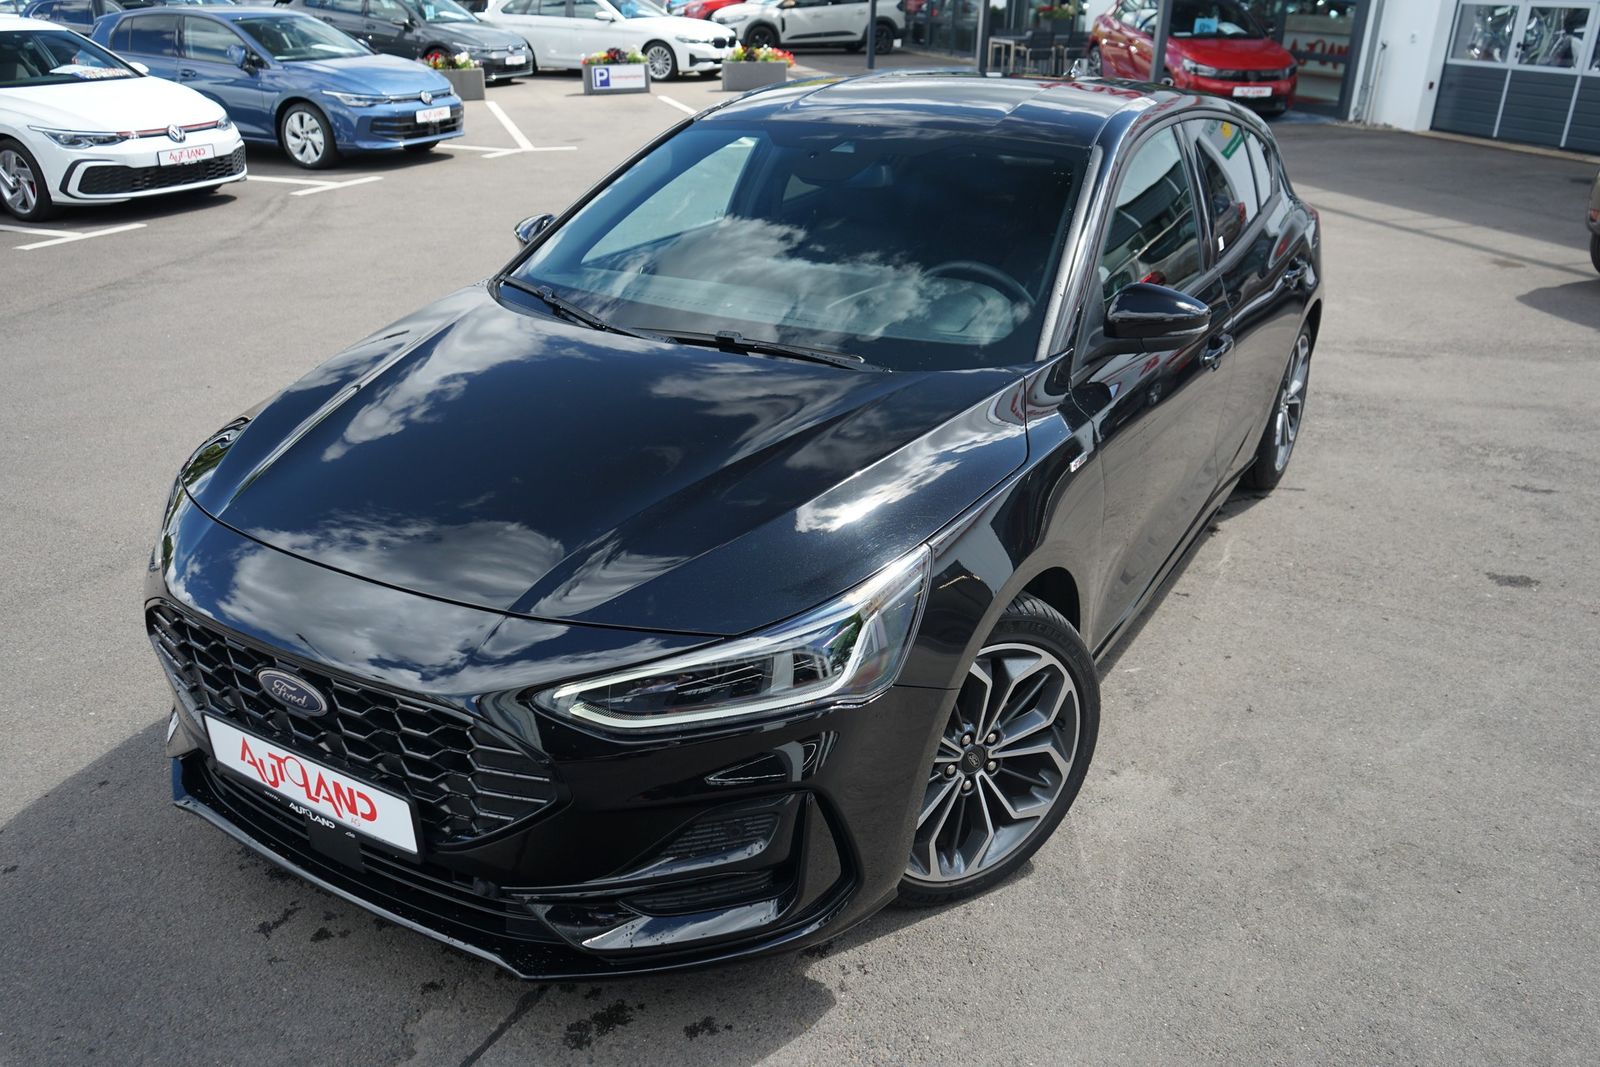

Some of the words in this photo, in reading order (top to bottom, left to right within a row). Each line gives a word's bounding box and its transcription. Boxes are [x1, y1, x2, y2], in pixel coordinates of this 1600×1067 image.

[595, 69, 608, 87] P
[271, 679, 308, 707] Ford
[240, 737, 378, 822] AUTOLAND
[288, 801, 336, 829] AUTOLAND
